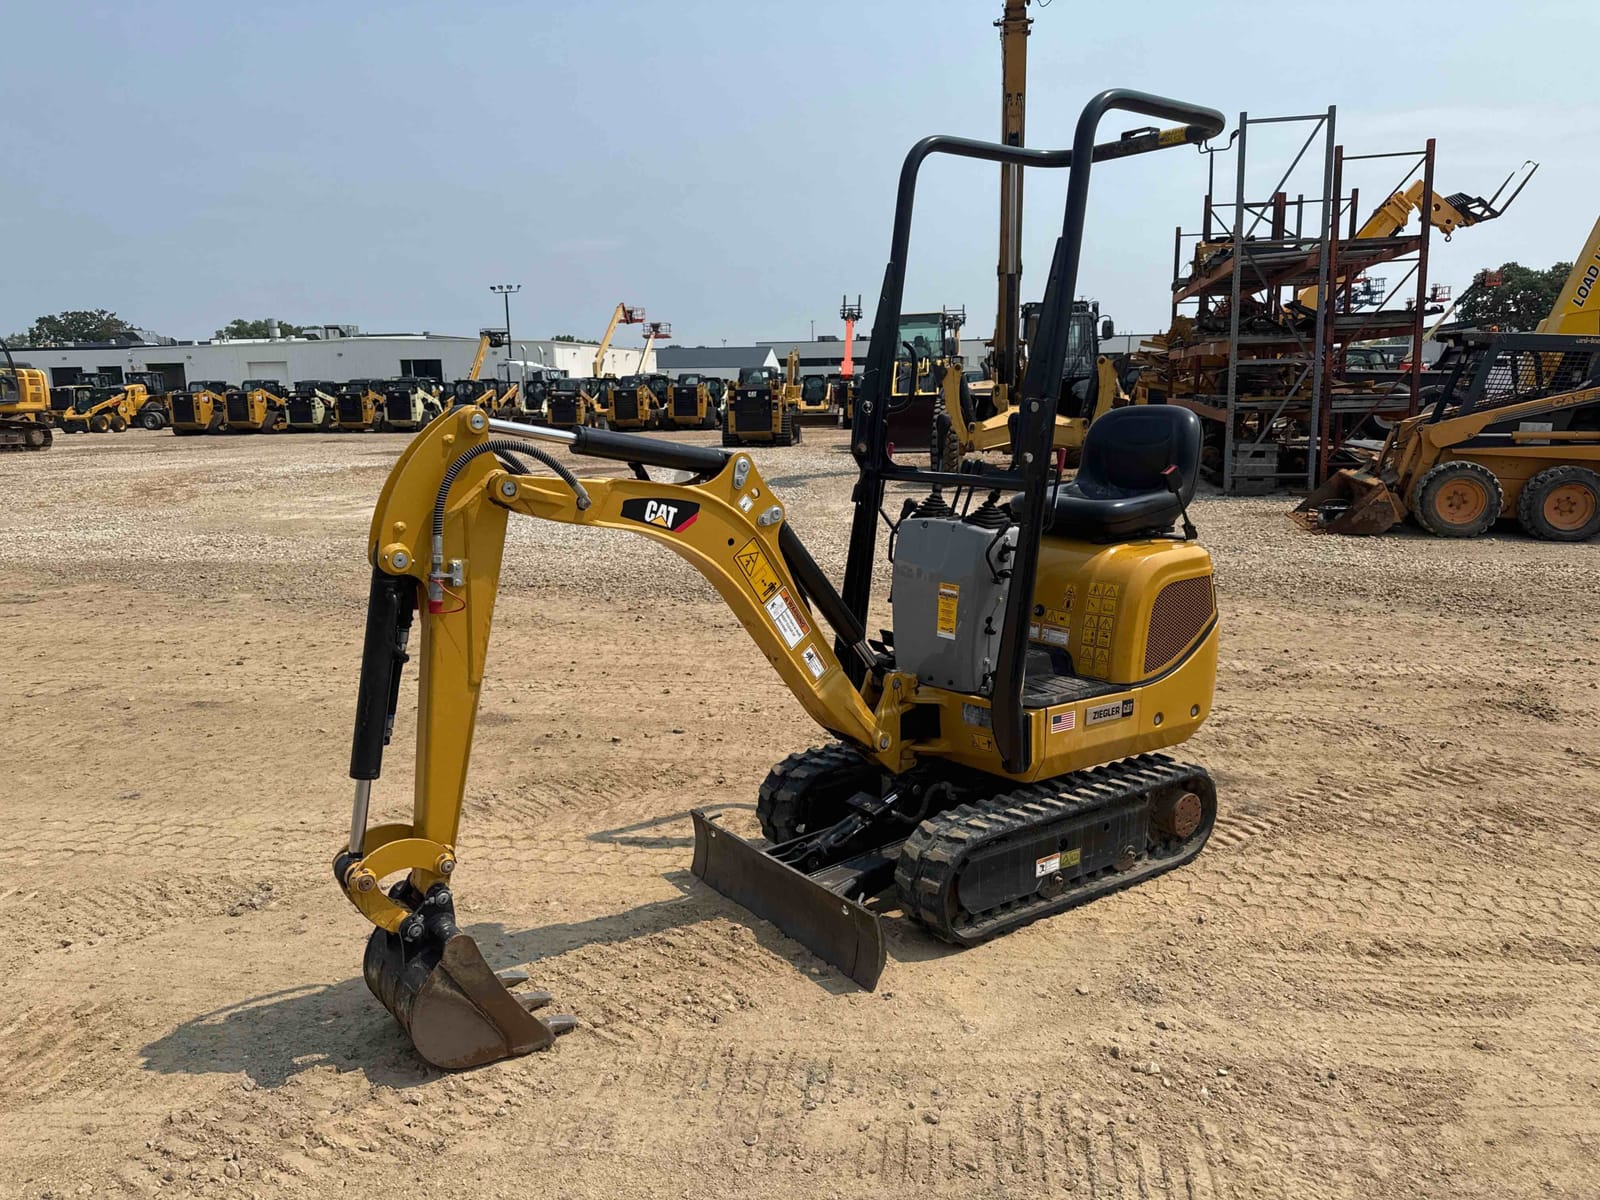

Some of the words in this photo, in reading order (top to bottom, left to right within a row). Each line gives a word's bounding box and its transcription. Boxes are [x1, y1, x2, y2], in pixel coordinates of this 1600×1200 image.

[1572, 265, 1599, 307] LOAD
[1554, 391, 1596, 407] CASE
[644, 501, 679, 528] CAT
[1092, 706, 1120, 720] ZIEGLER
